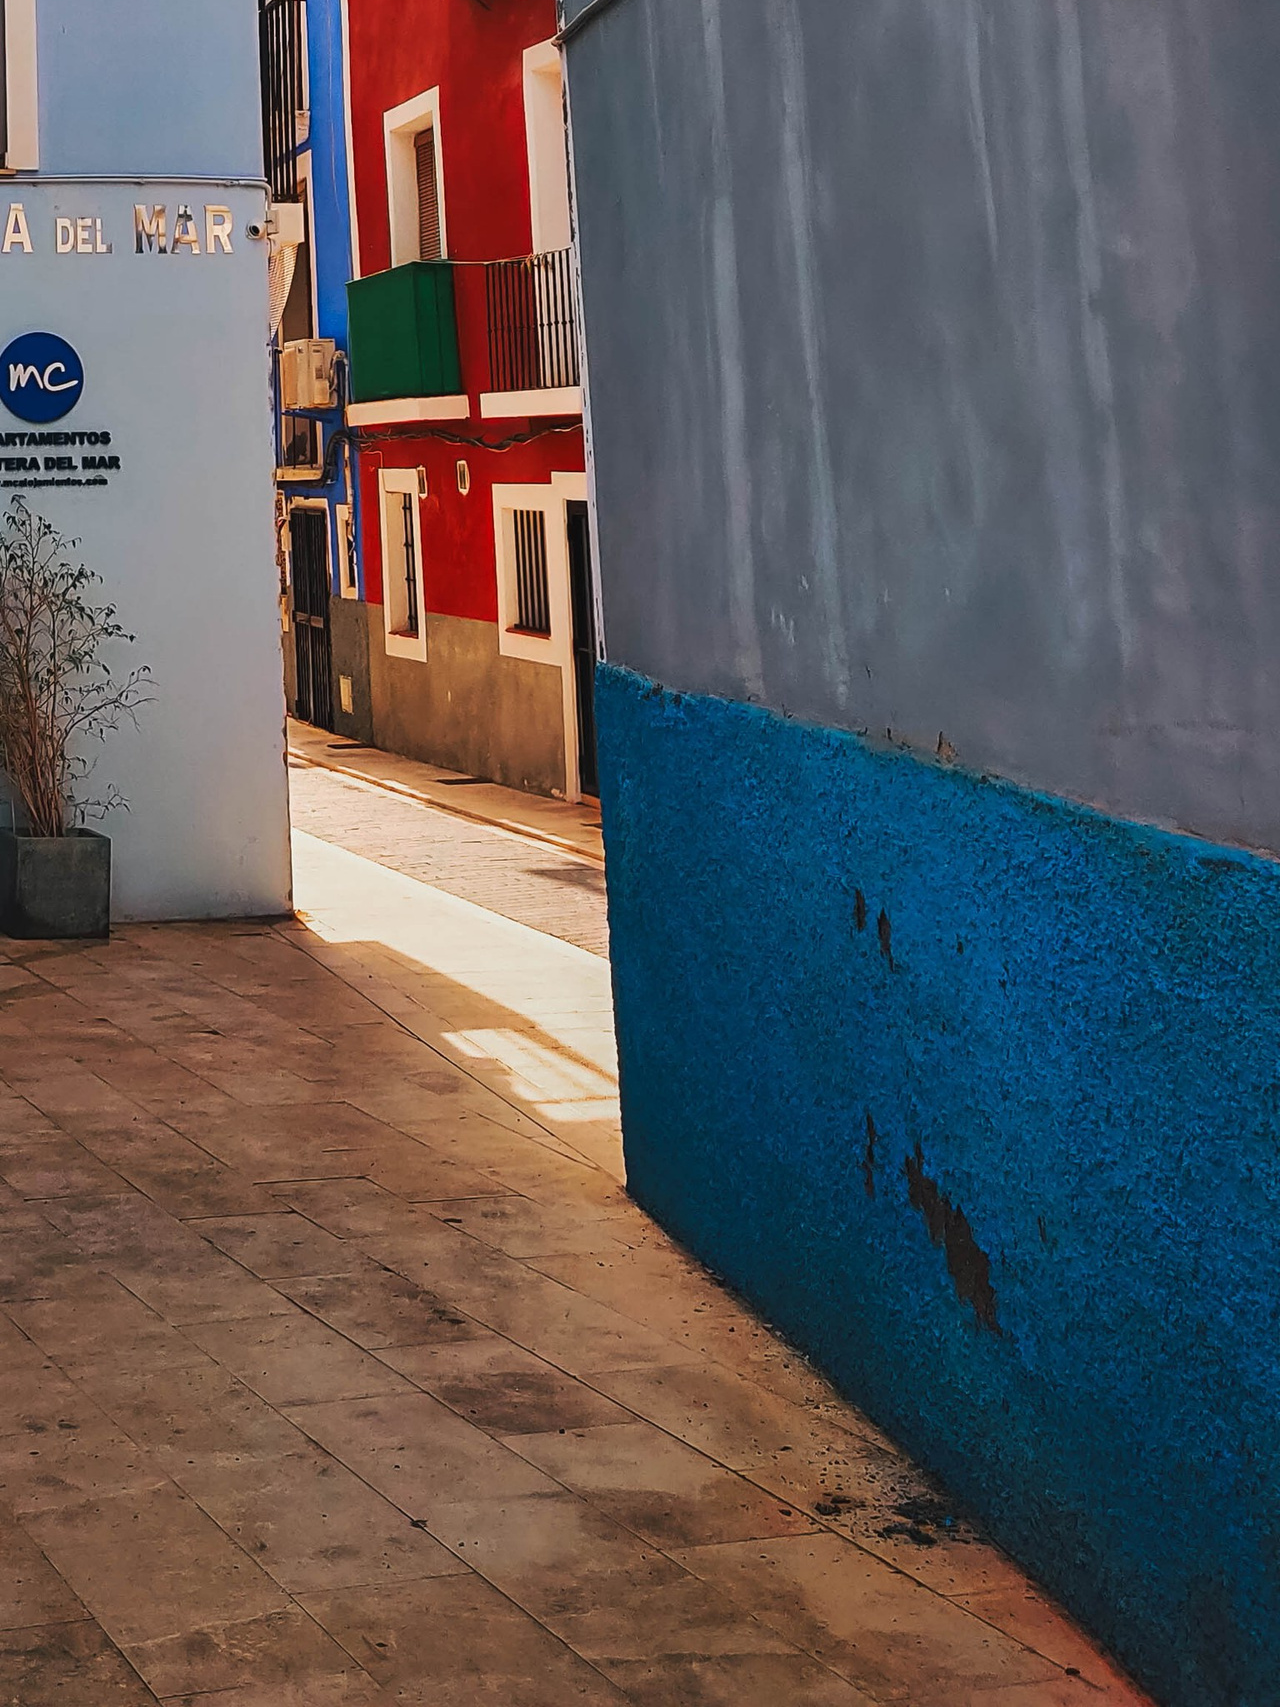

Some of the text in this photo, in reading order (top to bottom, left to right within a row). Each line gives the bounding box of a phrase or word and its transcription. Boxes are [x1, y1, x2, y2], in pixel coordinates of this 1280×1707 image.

[55, 216, 113, 255] DEL
[133, 202, 234, 255] MAR
[44, 457, 78, 471] DEL
[81, 456, 121, 470] MAR
